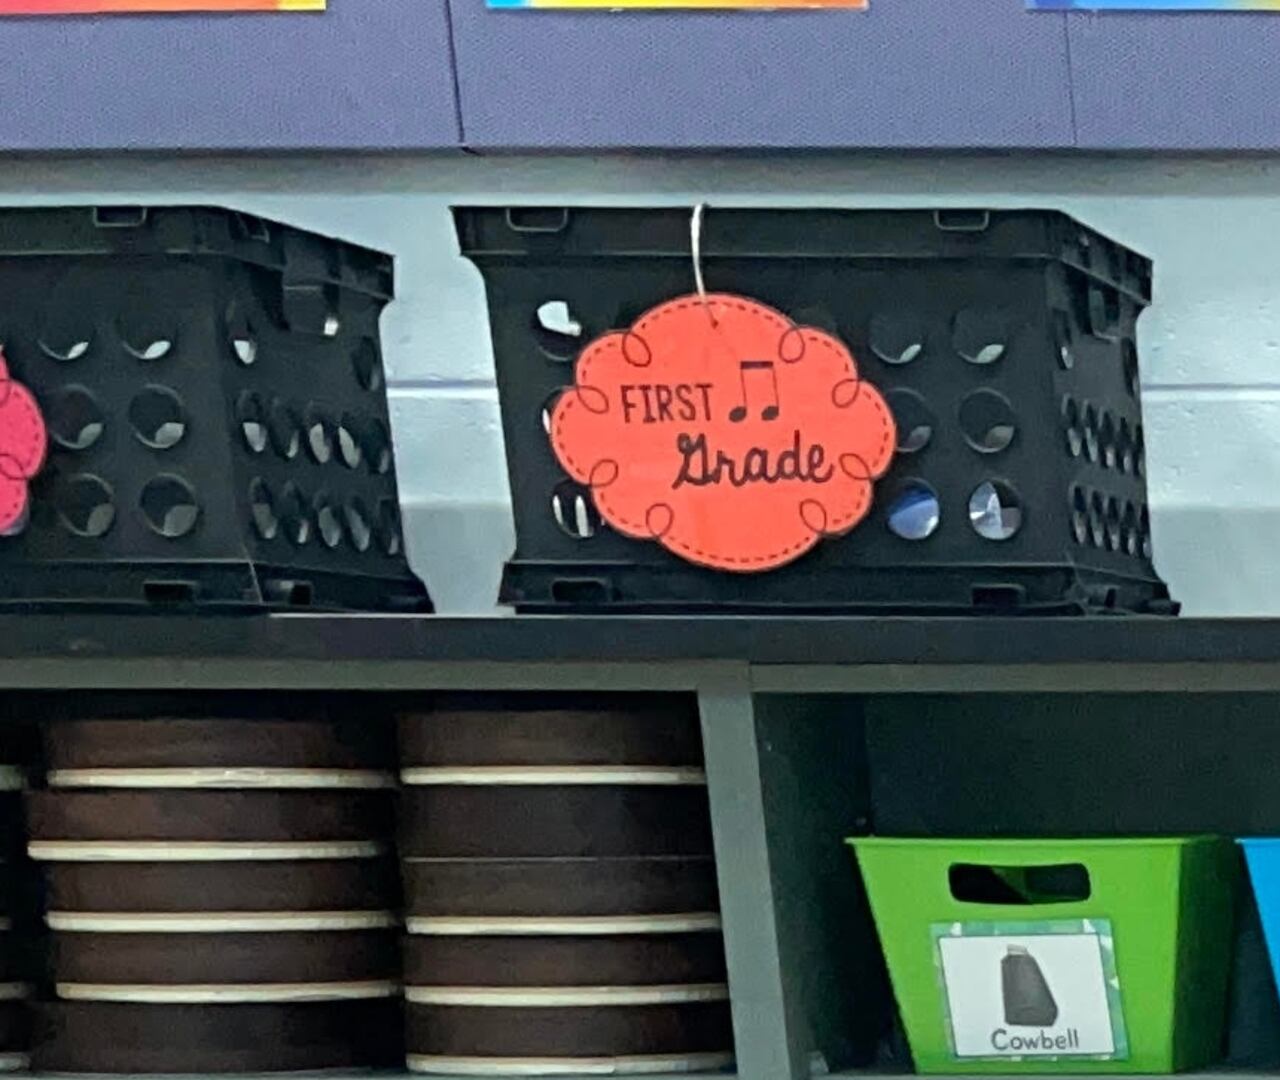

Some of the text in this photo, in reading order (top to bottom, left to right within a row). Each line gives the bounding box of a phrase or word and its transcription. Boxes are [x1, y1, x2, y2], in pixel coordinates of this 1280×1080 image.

[620, 383, 713, 424] FIRST
[671, 429, 835, 490] Grade
[990, 1028, 1080, 1051] Cowbell
